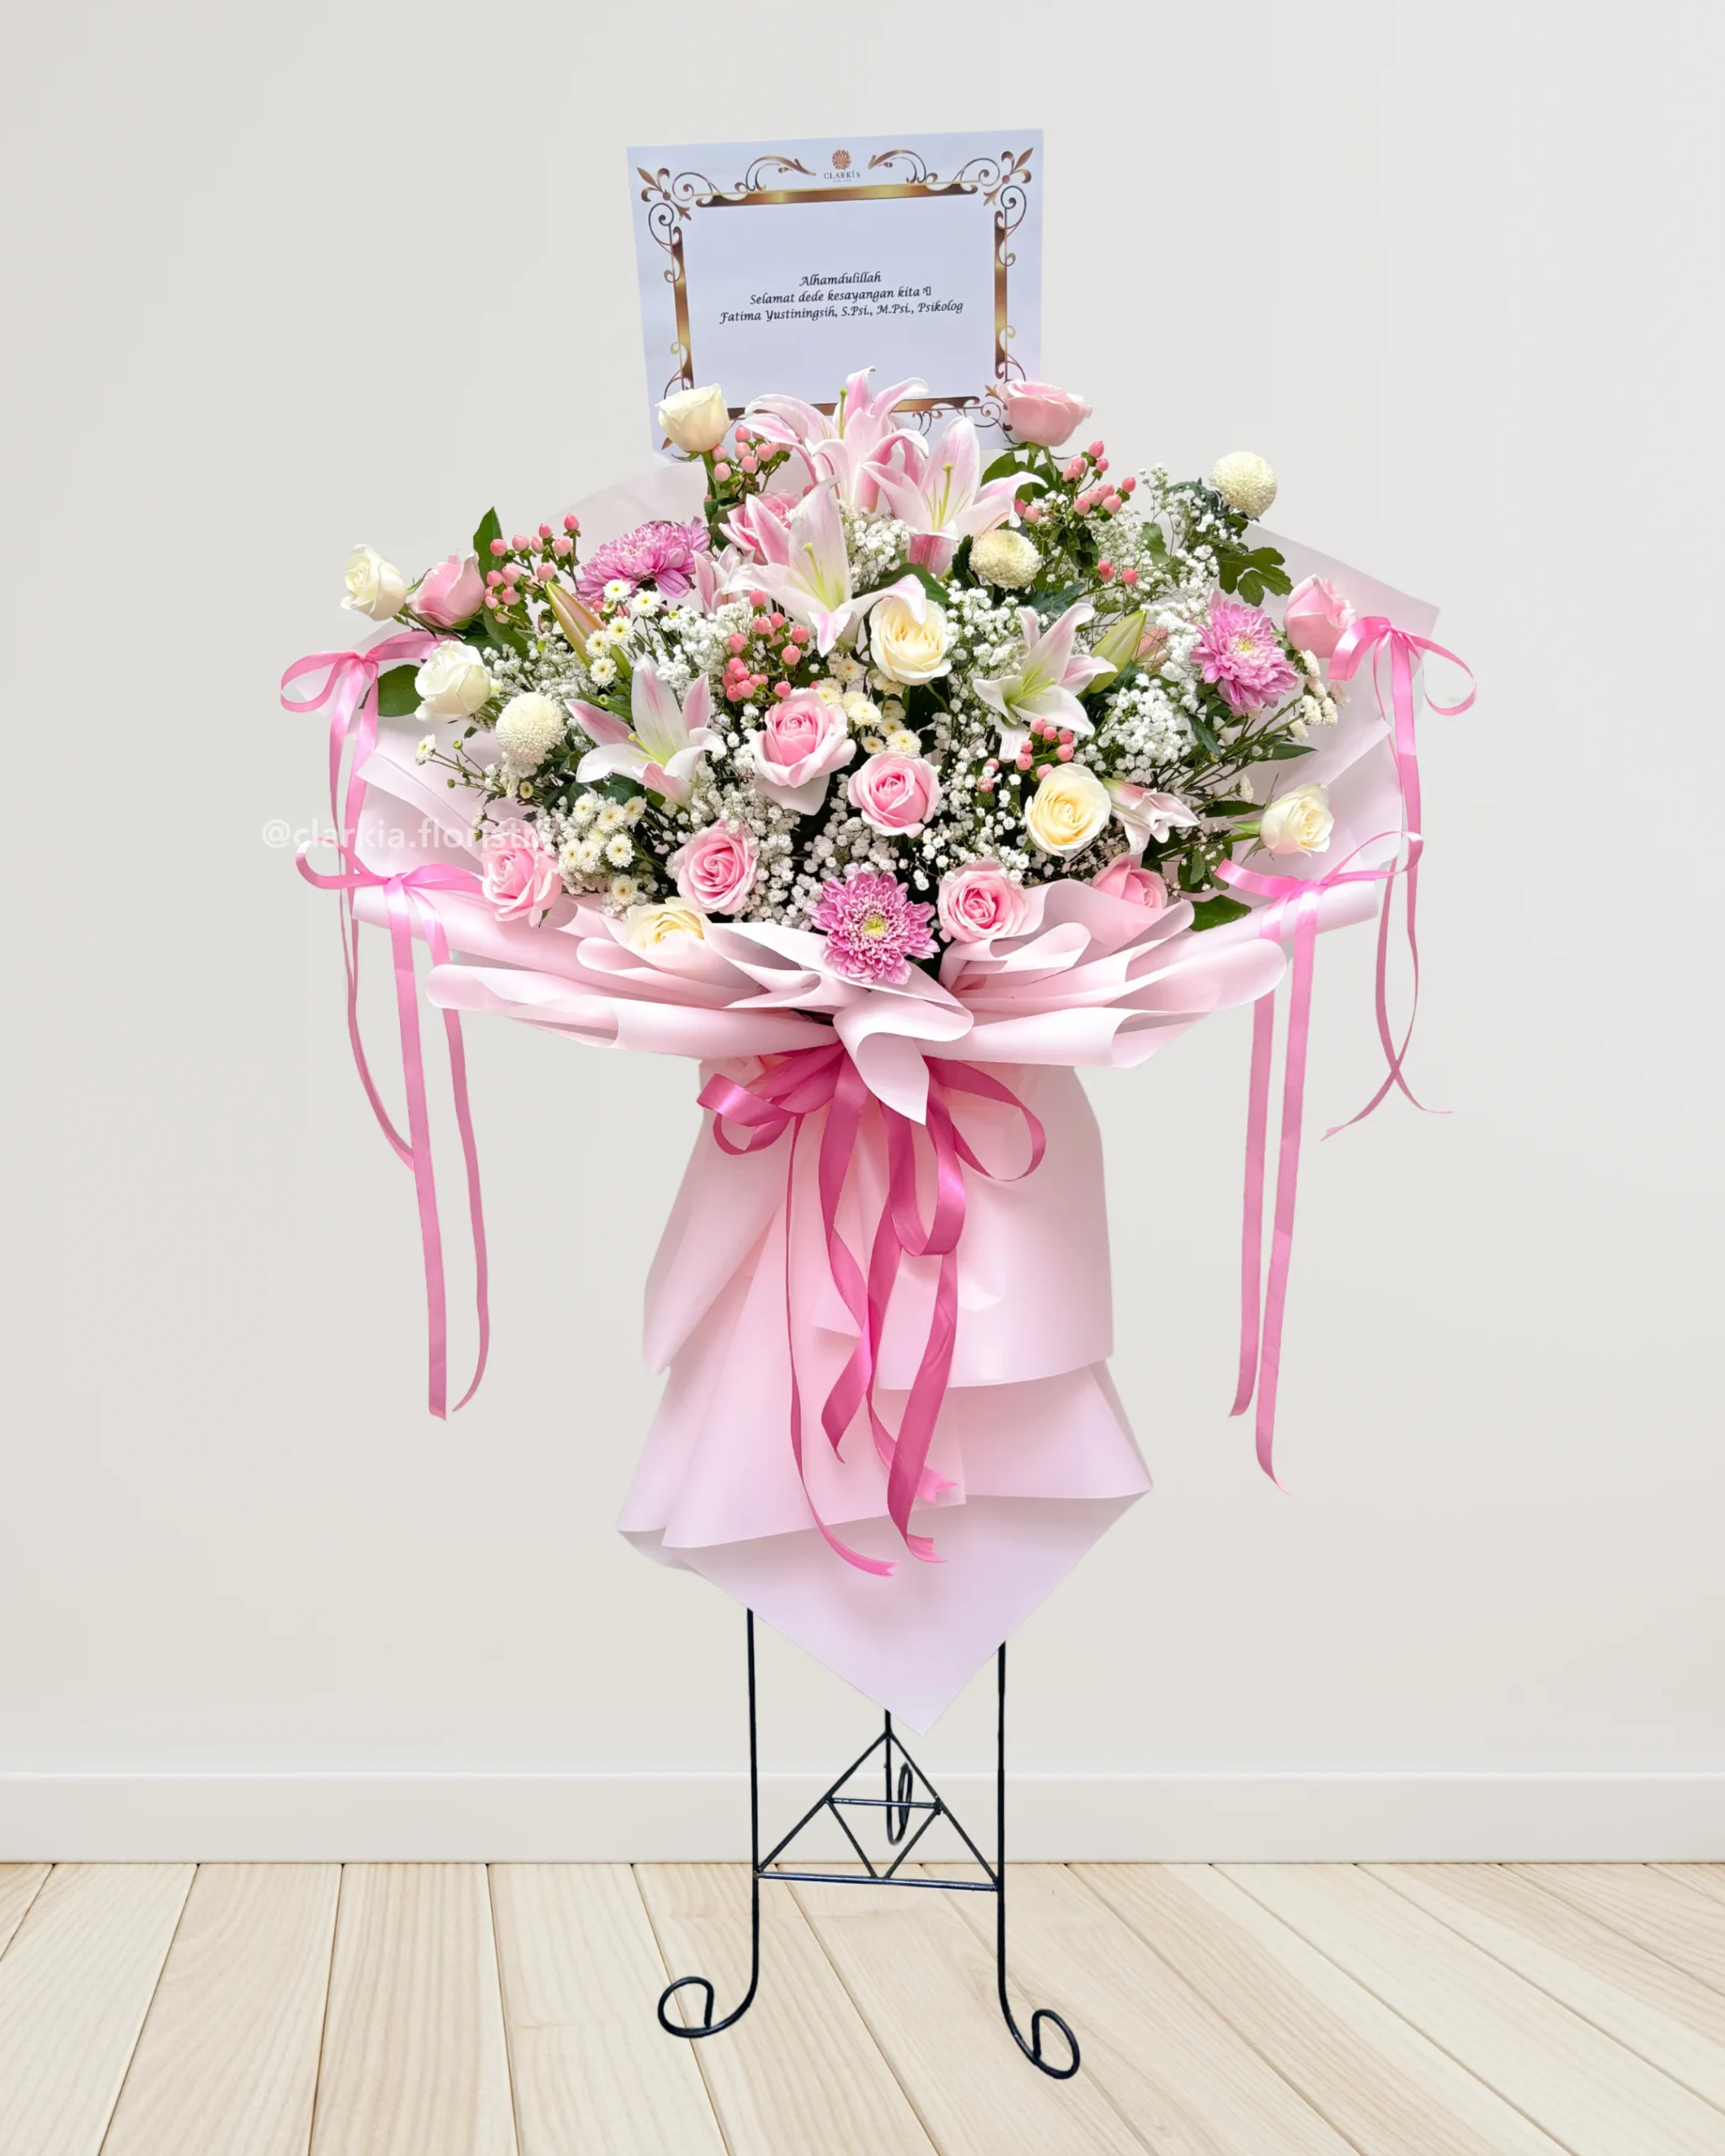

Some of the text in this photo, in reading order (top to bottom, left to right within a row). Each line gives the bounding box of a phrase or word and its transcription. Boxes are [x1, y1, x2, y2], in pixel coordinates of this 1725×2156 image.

[798, 271, 882, 286] Alhamdulillah
[750, 286, 921, 305] Selamat dede kesayangan kita
[719, 299, 964, 325] Fatima Yustiningsih, S.Psi., M.Psi., Psikolog
